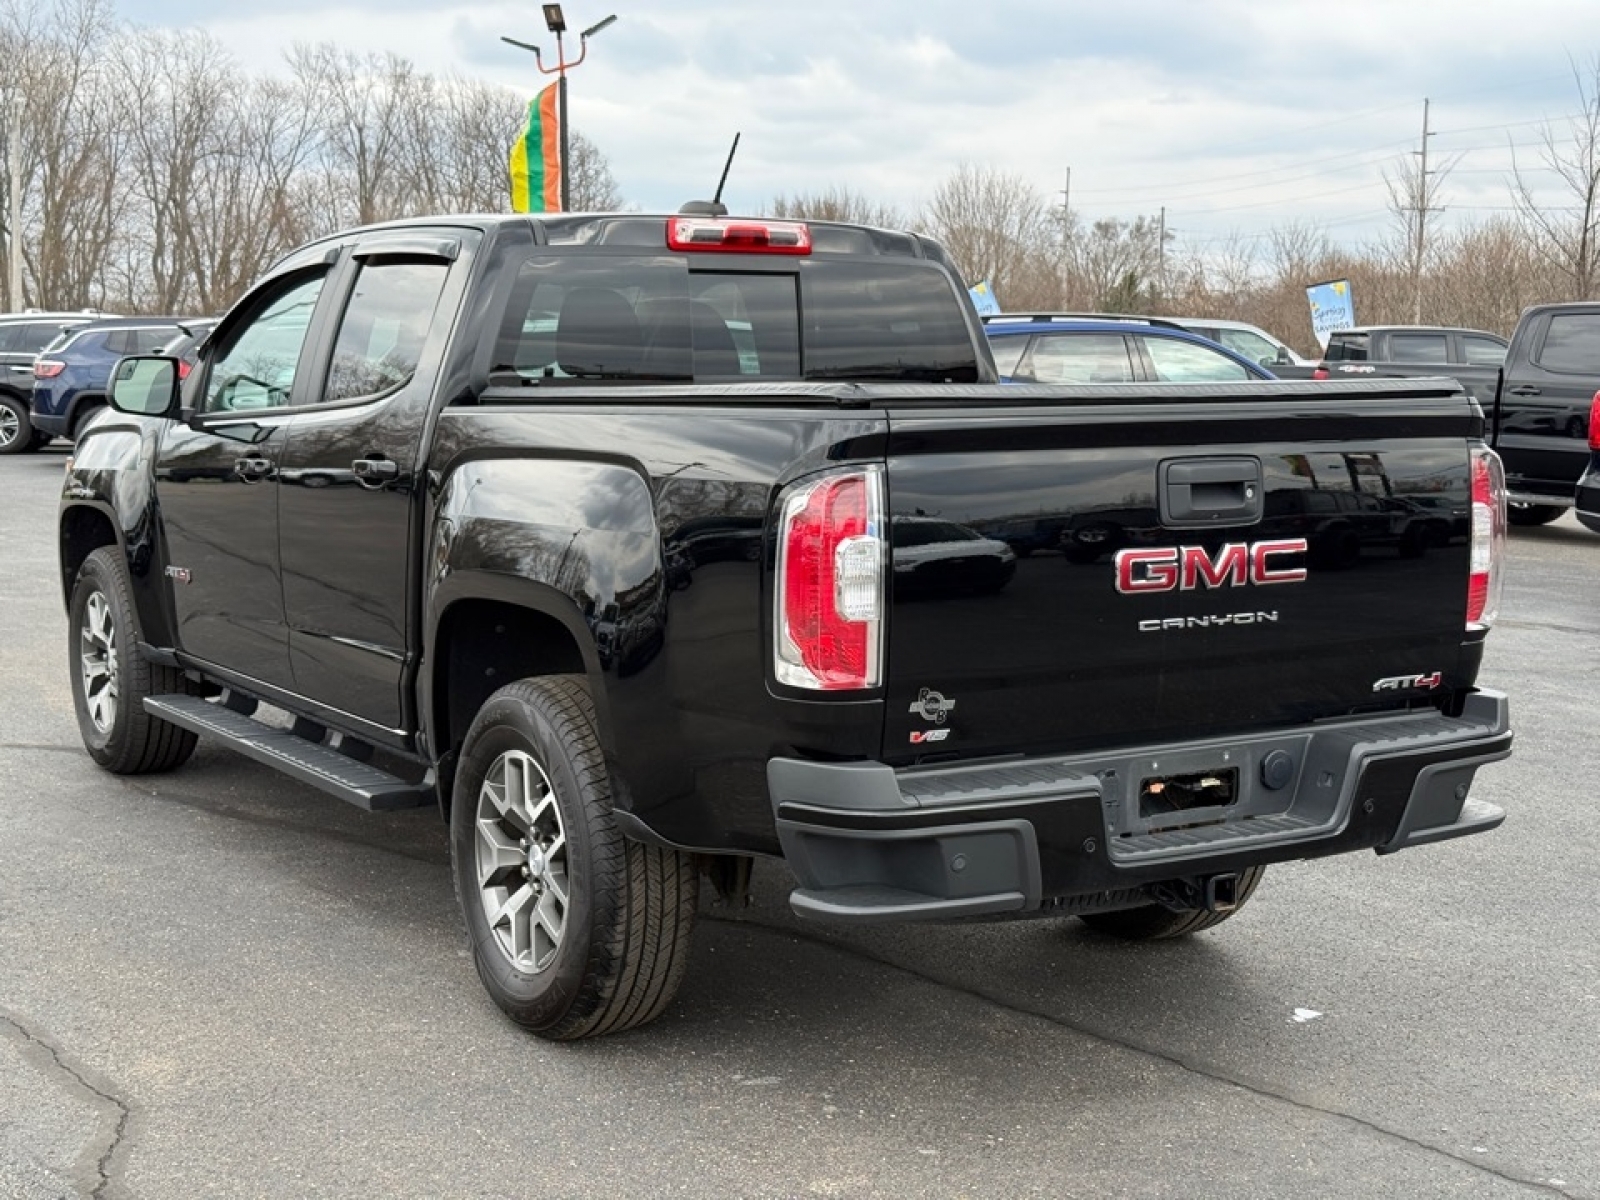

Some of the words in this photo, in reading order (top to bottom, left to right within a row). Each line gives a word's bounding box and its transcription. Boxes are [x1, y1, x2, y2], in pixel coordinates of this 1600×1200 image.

[1114, 538, 1308, 594] GMC
[1138, 610, 1279, 632] CANYON
[1372, 671, 1442, 692] AT4
